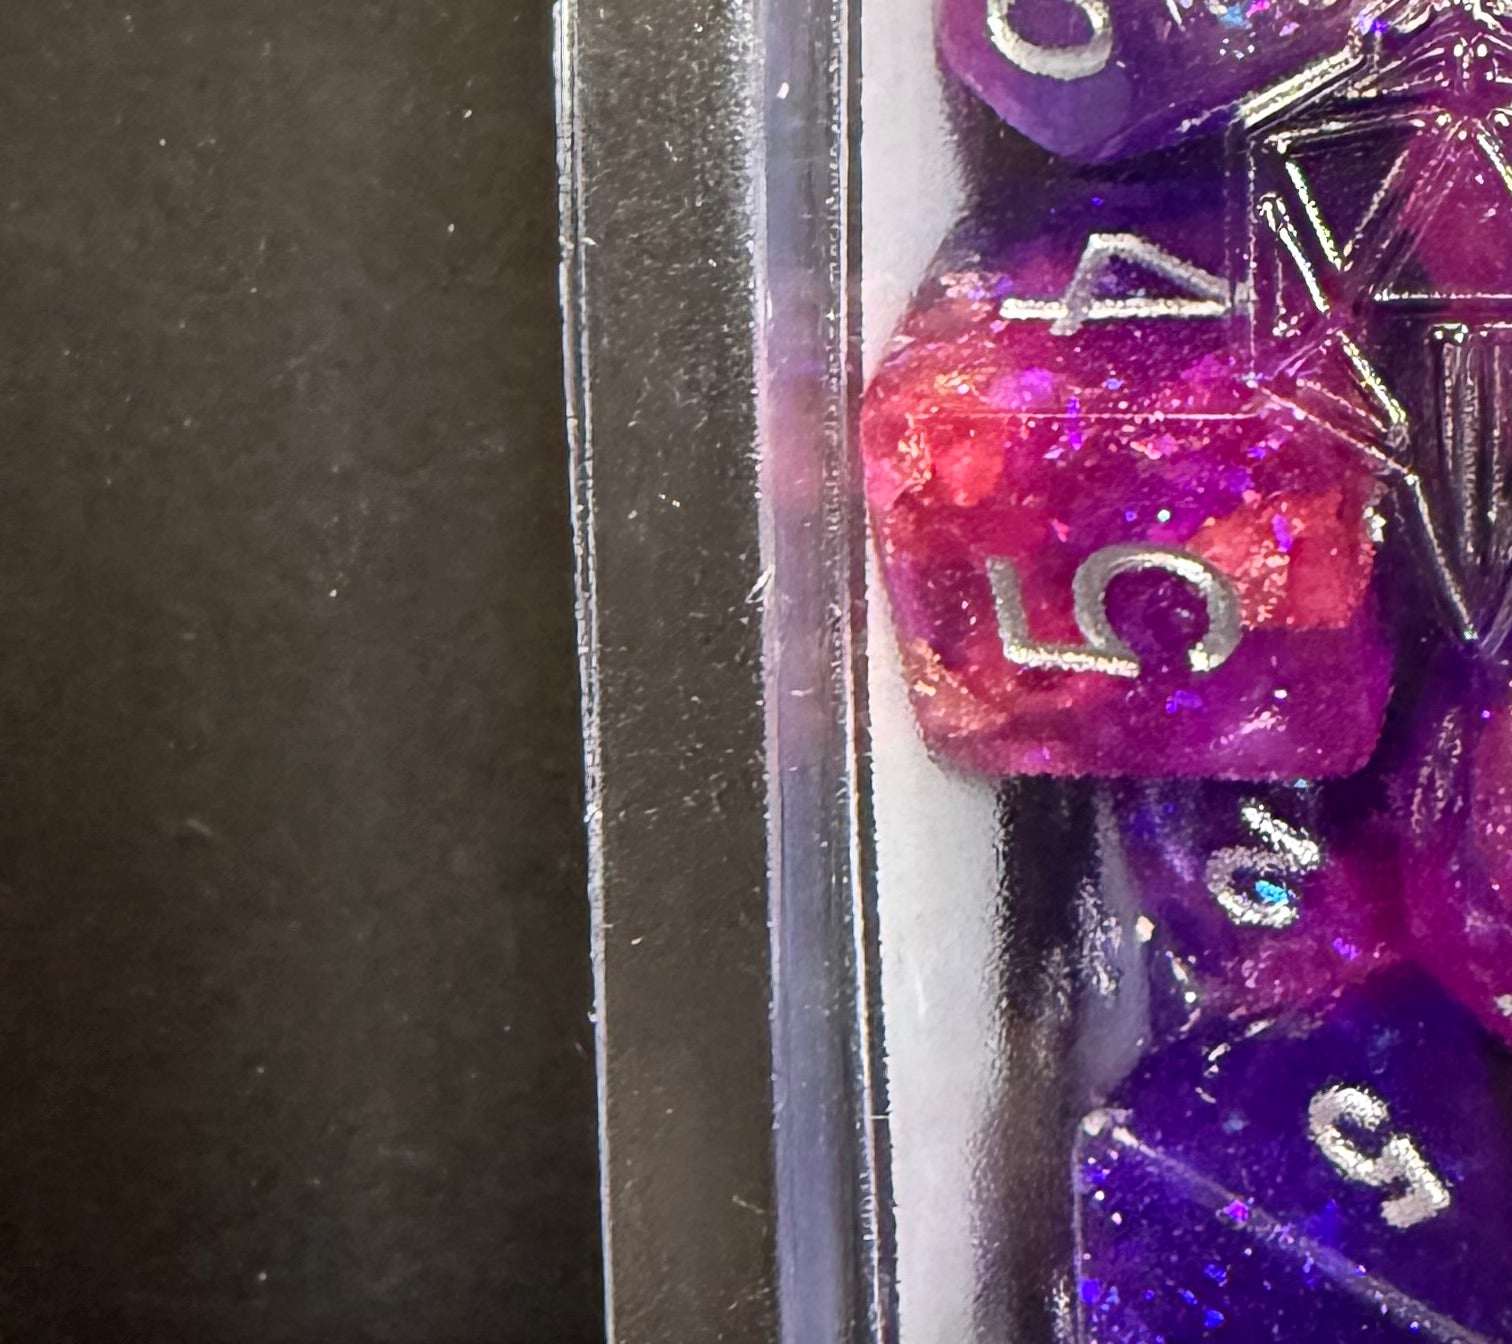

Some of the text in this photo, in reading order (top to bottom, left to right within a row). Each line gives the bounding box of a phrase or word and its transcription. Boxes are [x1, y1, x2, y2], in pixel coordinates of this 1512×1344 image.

[998, 232, 1255, 336] 4
[985, 545, 1244, 676] 5
[1308, 1083, 1452, 1229] 5
